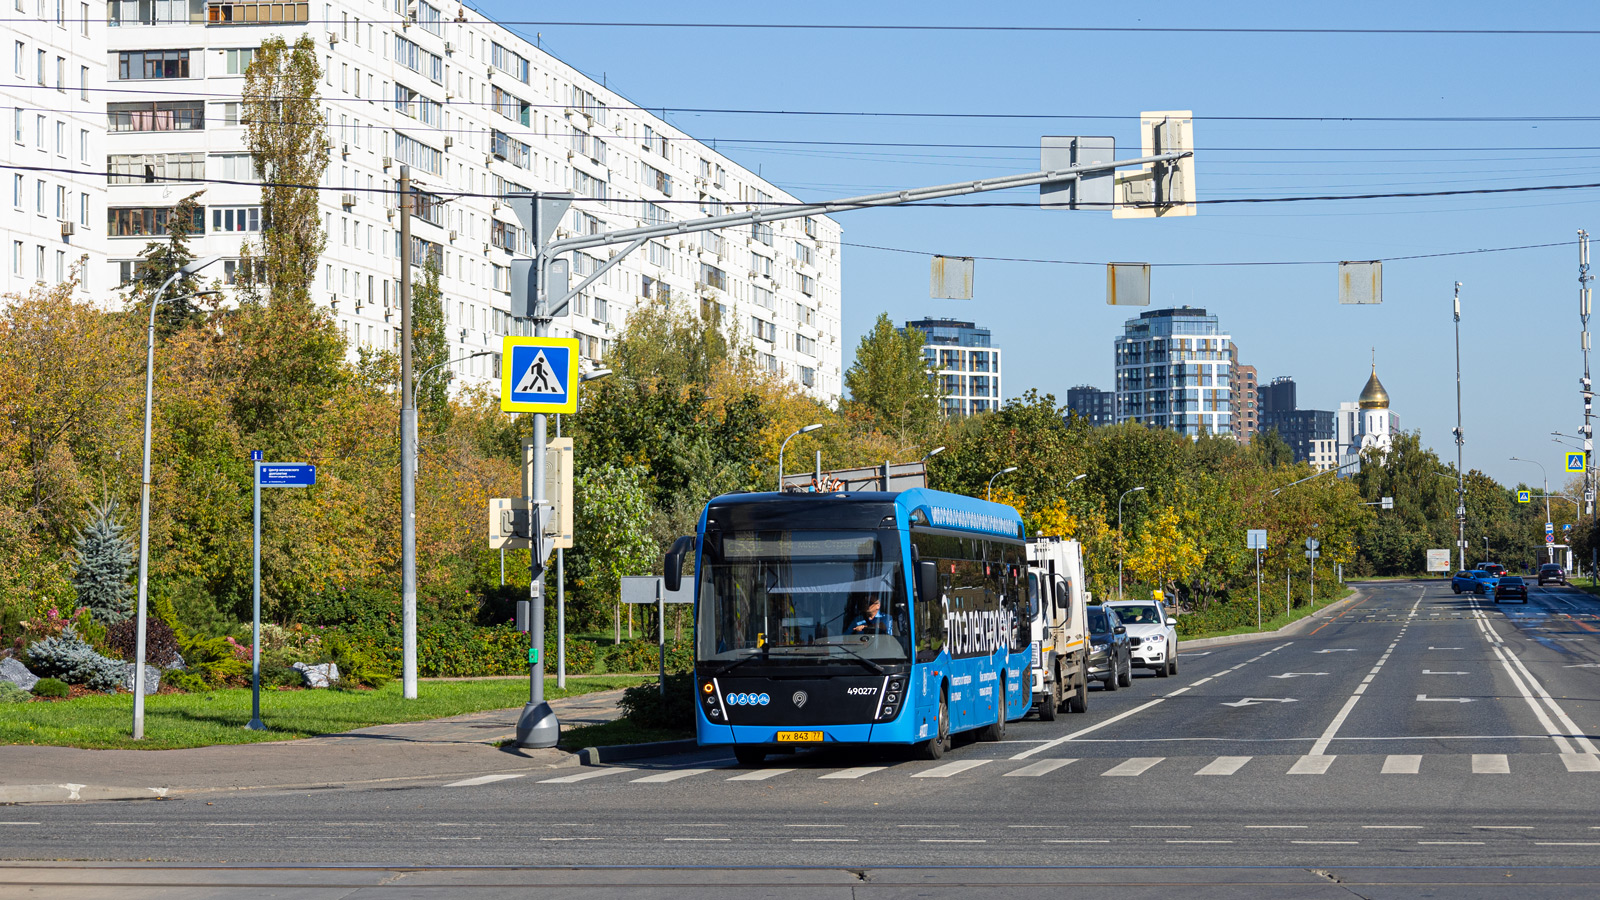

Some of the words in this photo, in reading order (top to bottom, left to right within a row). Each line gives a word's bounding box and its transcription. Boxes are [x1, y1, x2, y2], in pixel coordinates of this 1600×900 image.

[941, 594, 962, 655] Это
[847, 687, 878, 695] 490277
[794, 732, 809, 740] 843
